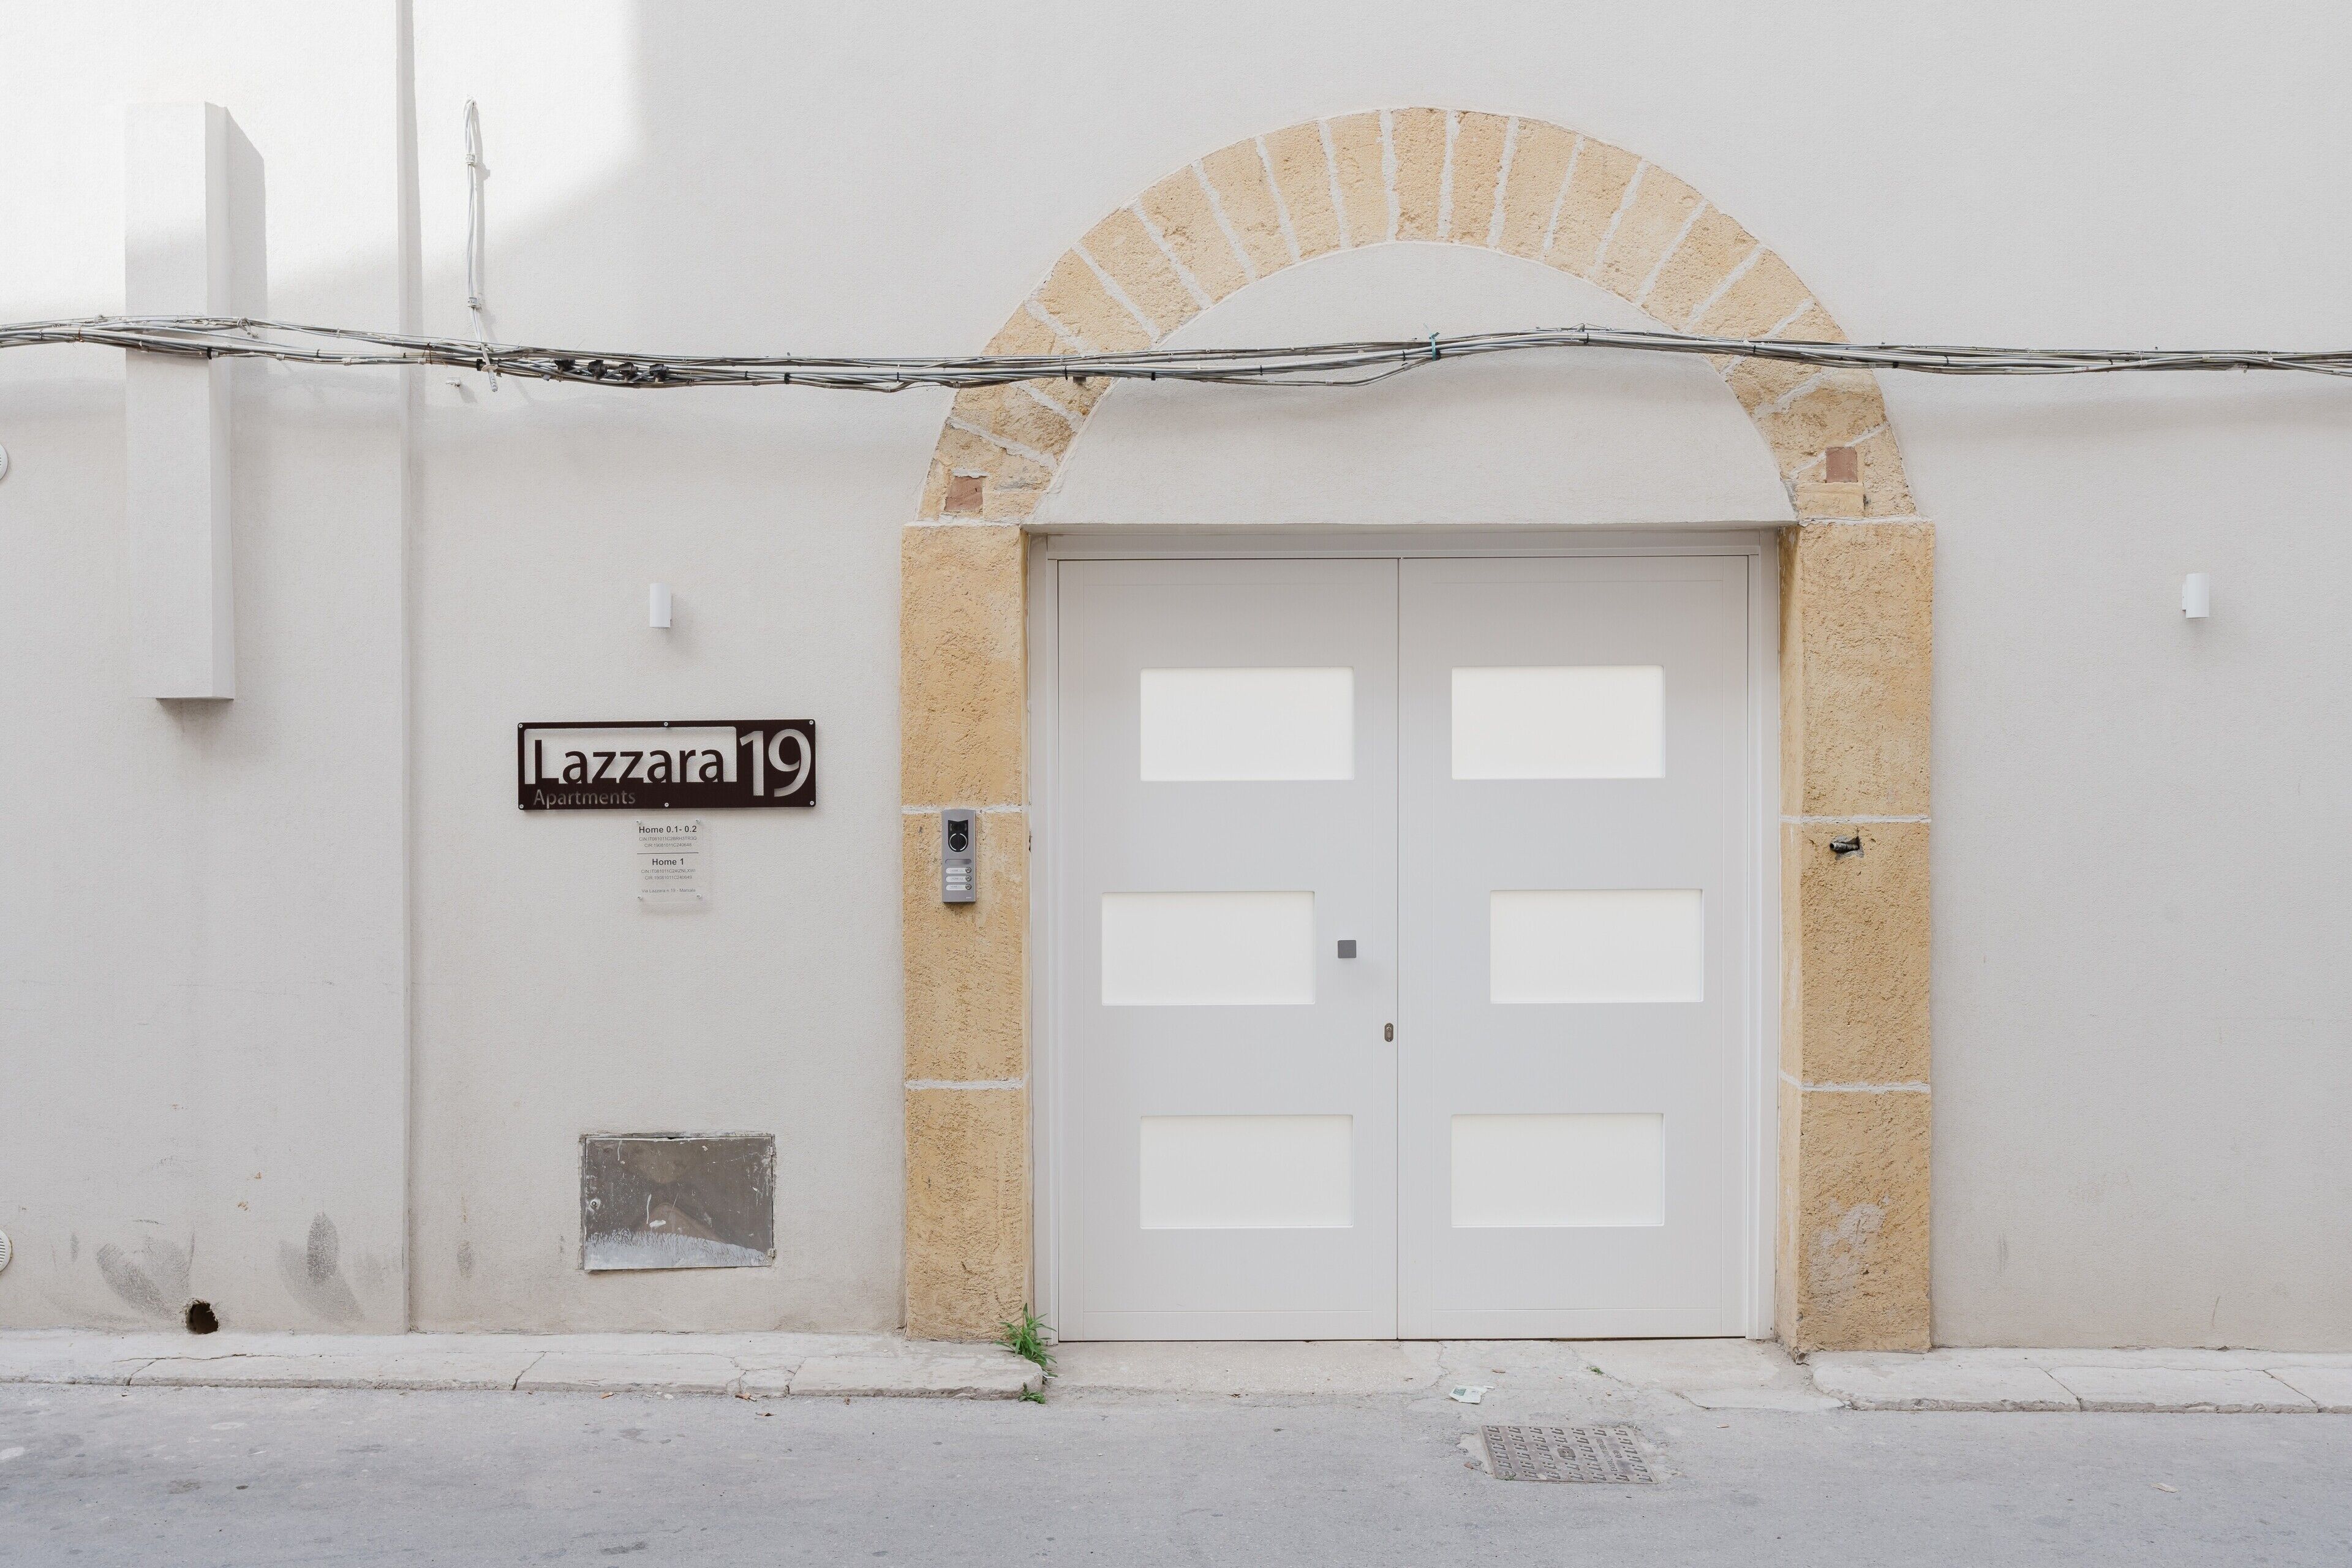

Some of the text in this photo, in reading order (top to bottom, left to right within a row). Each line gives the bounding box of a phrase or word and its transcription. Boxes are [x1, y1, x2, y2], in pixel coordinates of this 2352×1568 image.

[534, 728, 812, 797] Lazzara 19
[533, 788, 636, 809] Apartments
